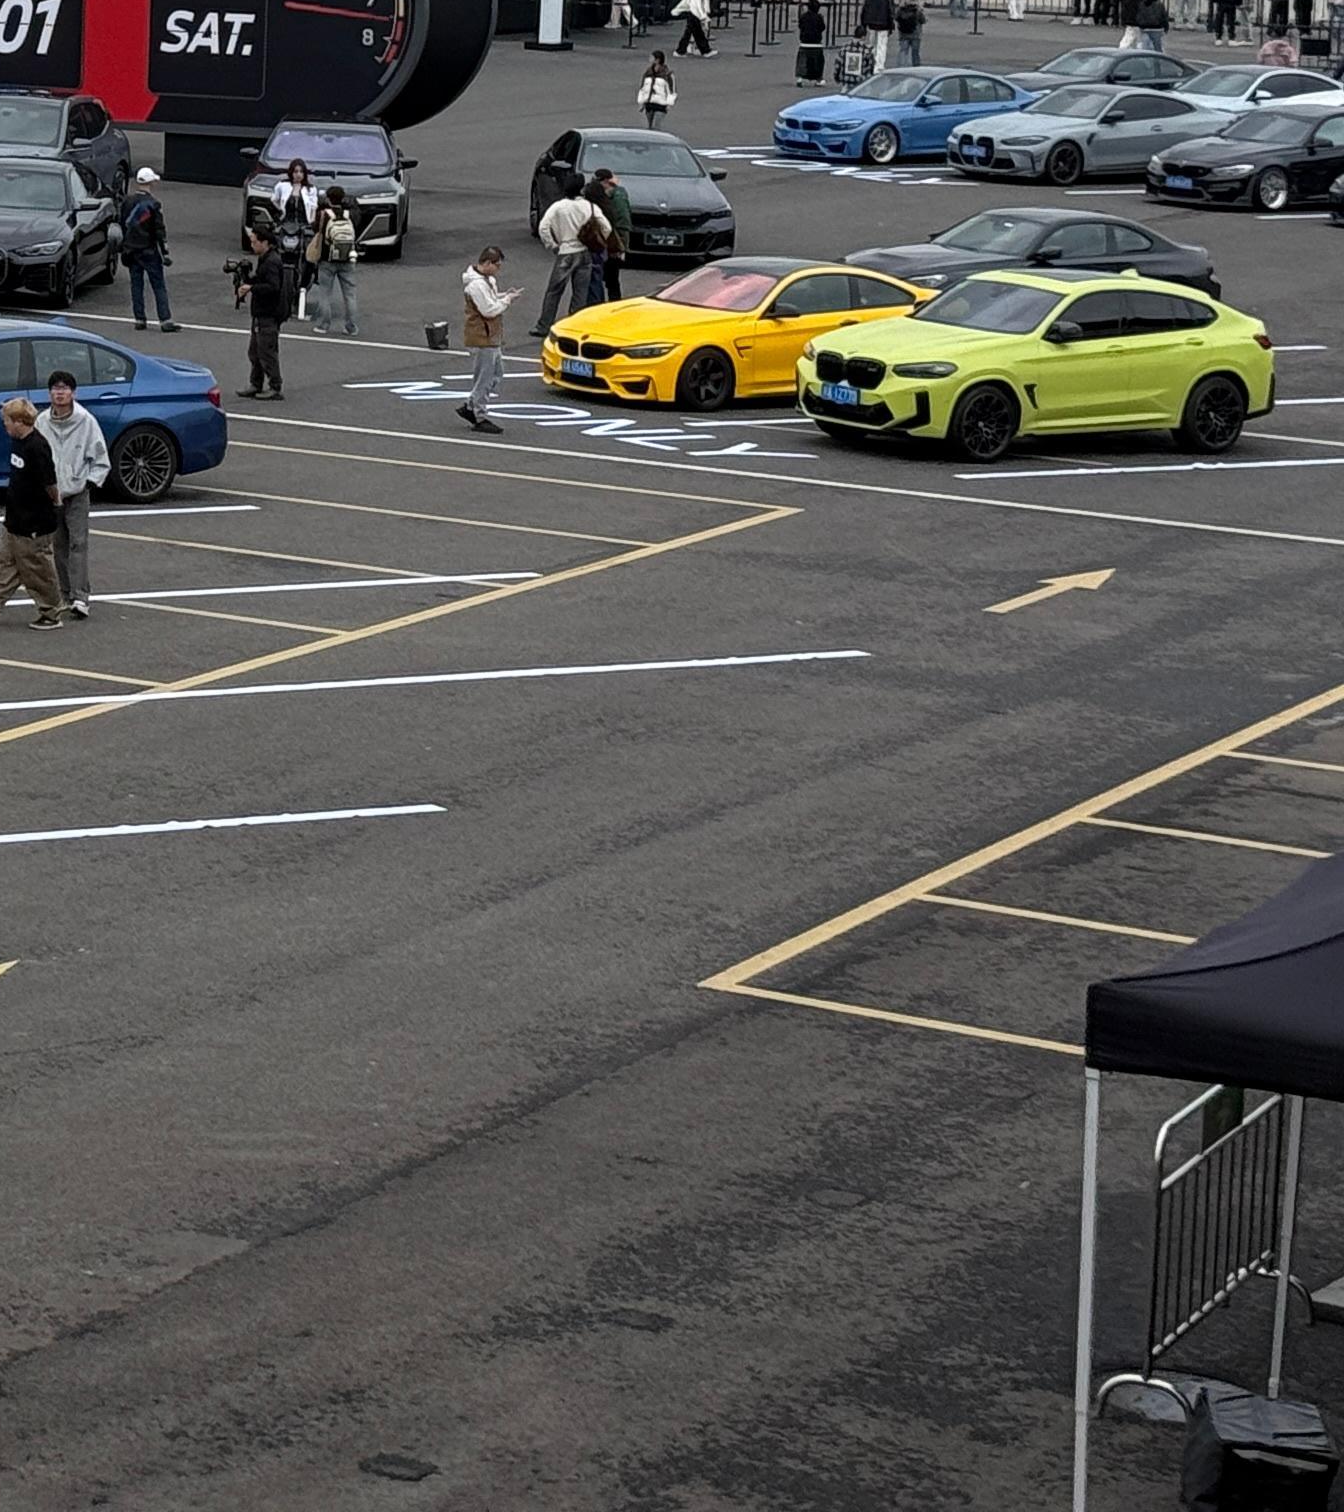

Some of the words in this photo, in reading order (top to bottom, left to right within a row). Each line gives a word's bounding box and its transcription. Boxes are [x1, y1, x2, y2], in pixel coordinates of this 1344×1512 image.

[160, 10, 256, 56] SAT.
[361, 29, 374, 46] 8
[484, 402, 820, 459] ONLY
